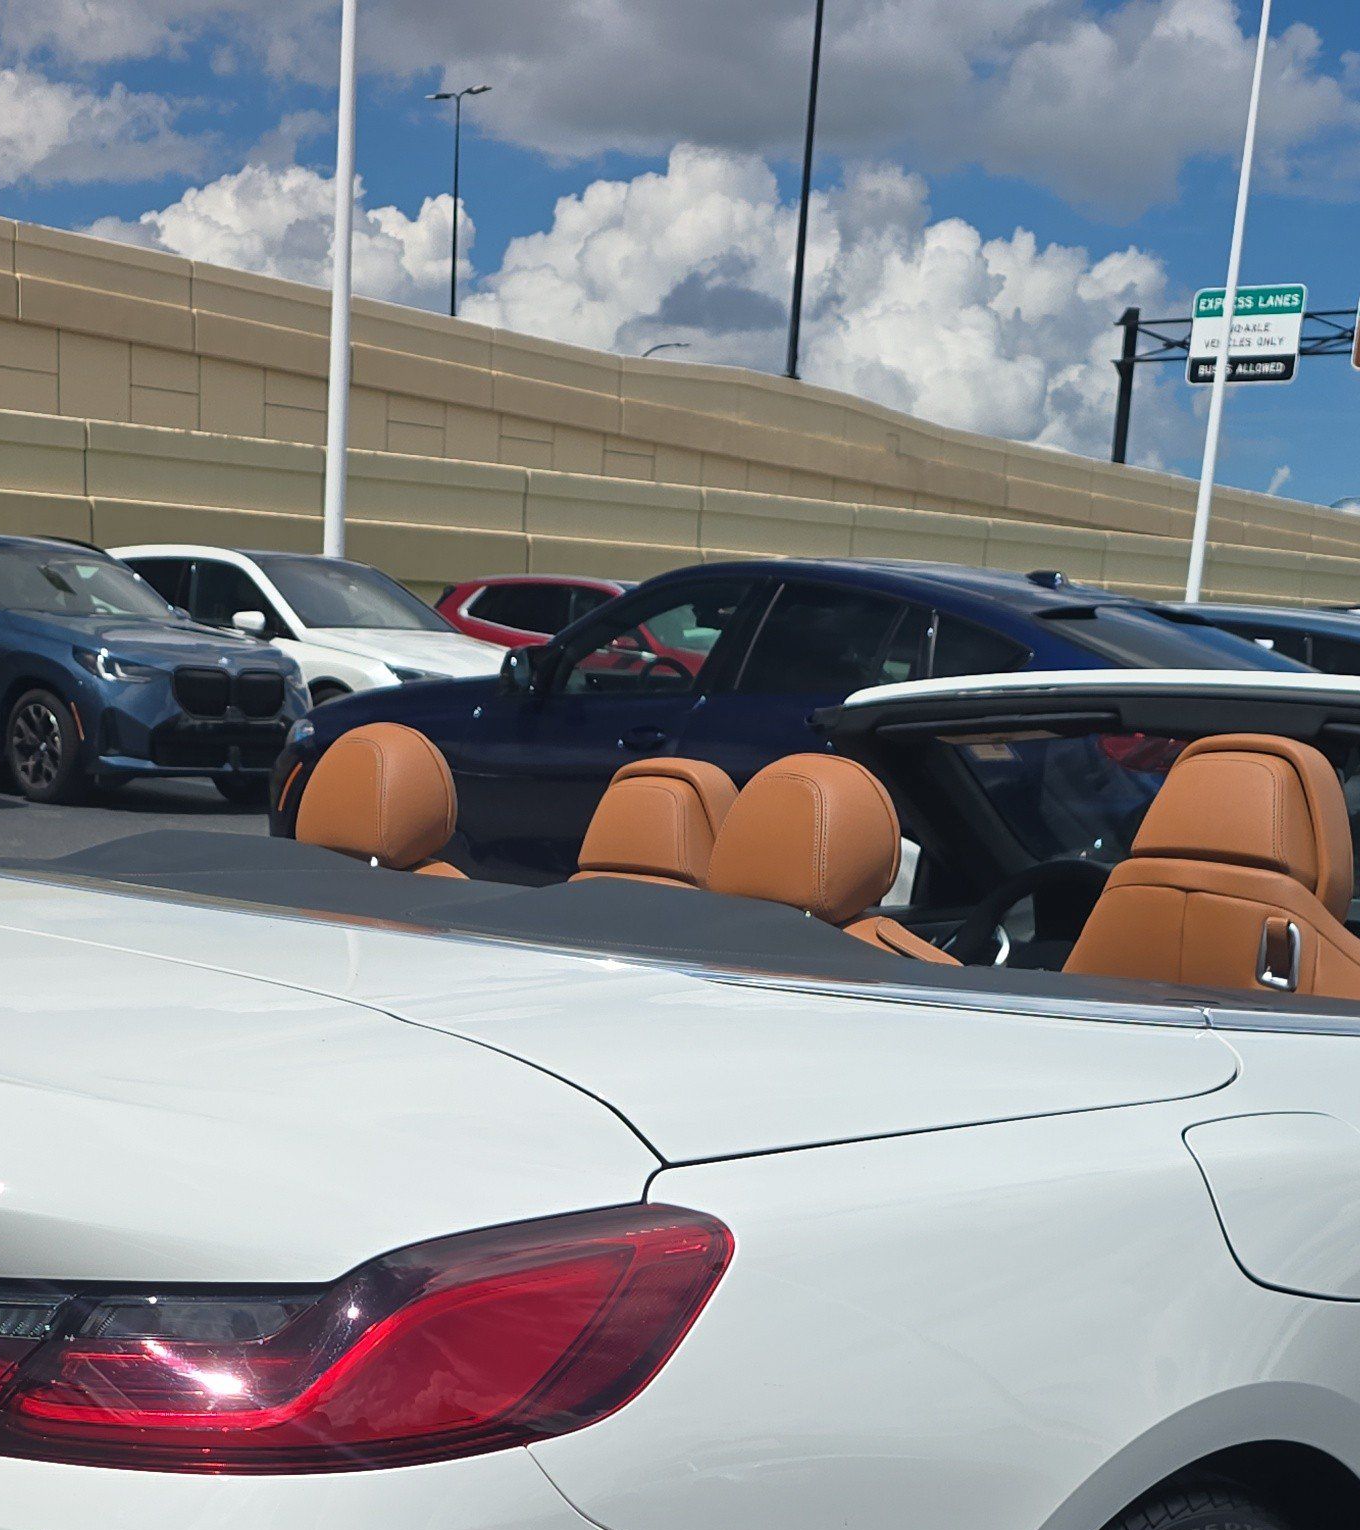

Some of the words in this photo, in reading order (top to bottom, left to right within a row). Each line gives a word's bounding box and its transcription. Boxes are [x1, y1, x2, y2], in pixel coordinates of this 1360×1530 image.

[1258, 294, 1301, 308] LANES
[1256, 336, 1285, 347] ONLY
[1235, 360, 1286, 376] ALLOWED
